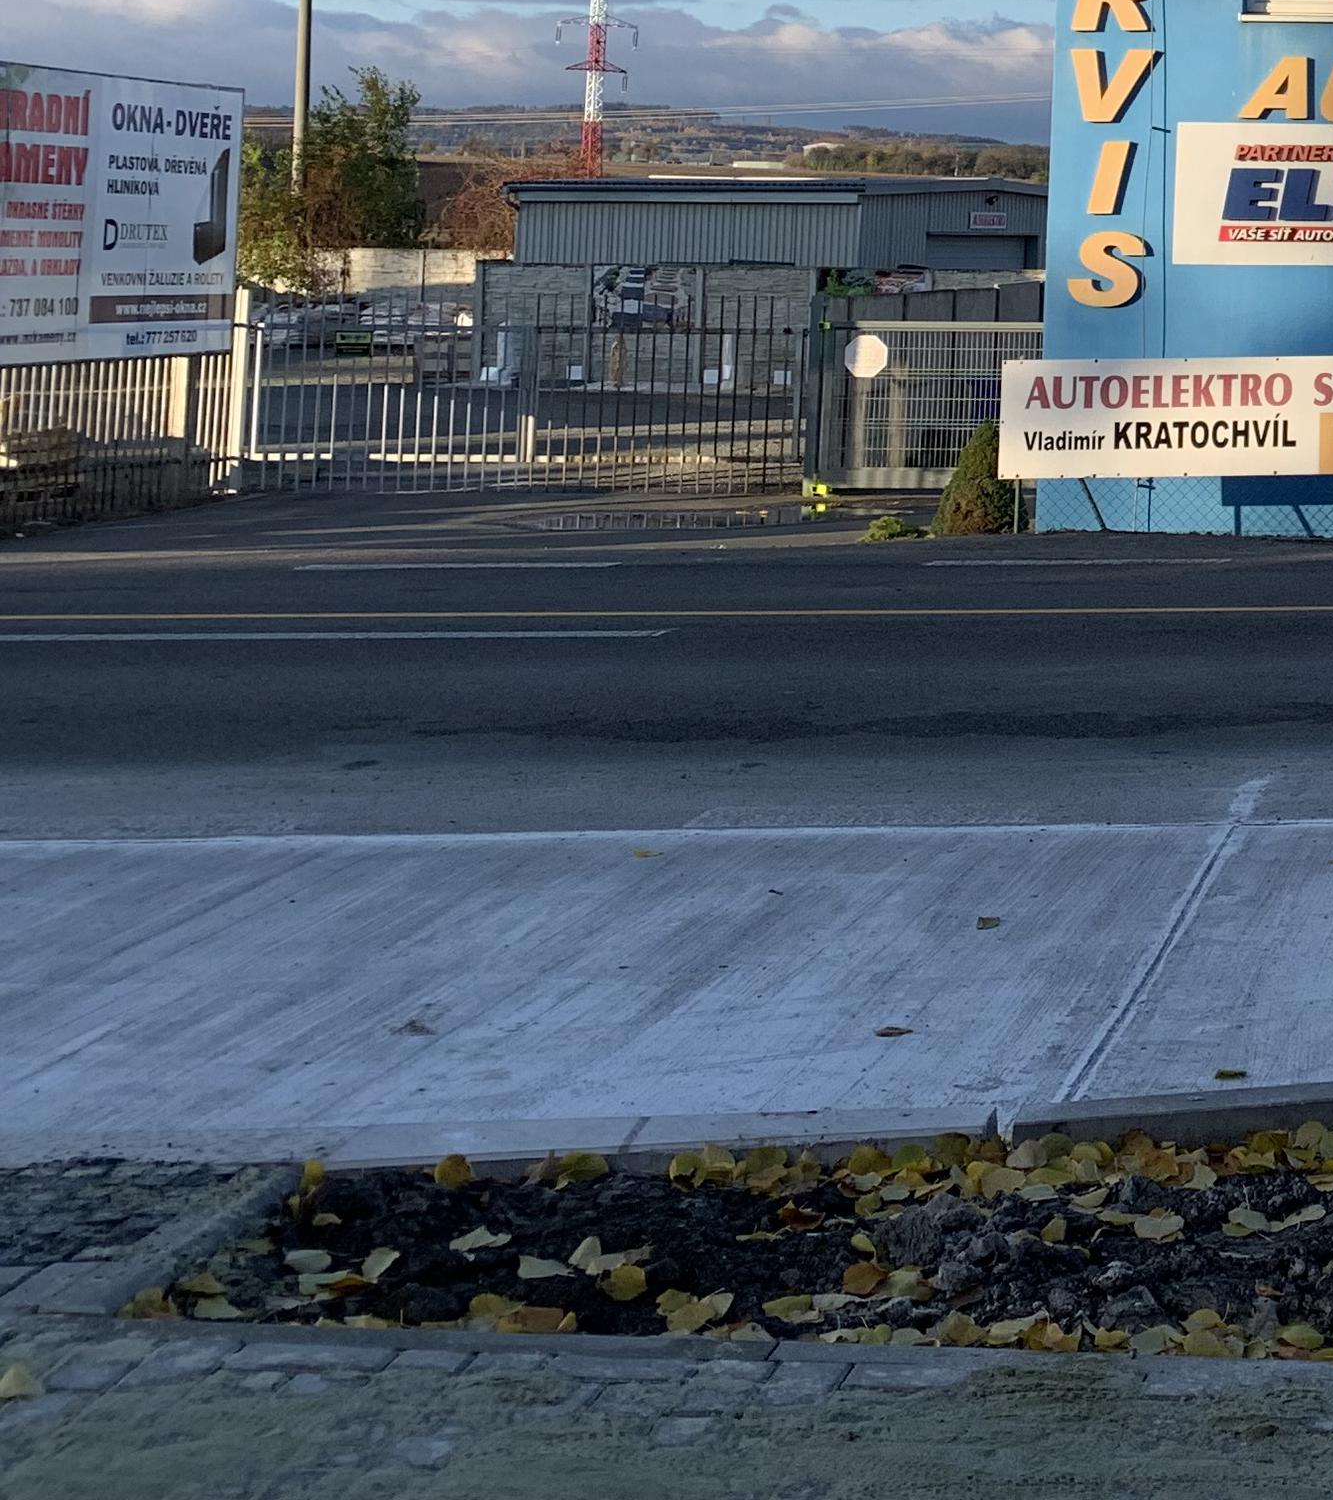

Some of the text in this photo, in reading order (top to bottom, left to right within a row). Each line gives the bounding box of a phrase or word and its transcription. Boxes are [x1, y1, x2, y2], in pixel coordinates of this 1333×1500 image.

[108, 153, 207, 176] PLASTOVÁ, DŘEVĚNÁ
[106, 176, 160, 196] HLINÍKOVÁ
[119, 223, 168, 241] DRUTEX
[1228, 226, 1266, 241] VAŠE
[1269, 227, 1292, 241] SÍŤ
[9, 298, 30, 317] 737
[1025, 373, 1293, 409] AUTOELEKTRO
[1024, 414, 1297, 452] Vladimír KRATOCHVÍL
